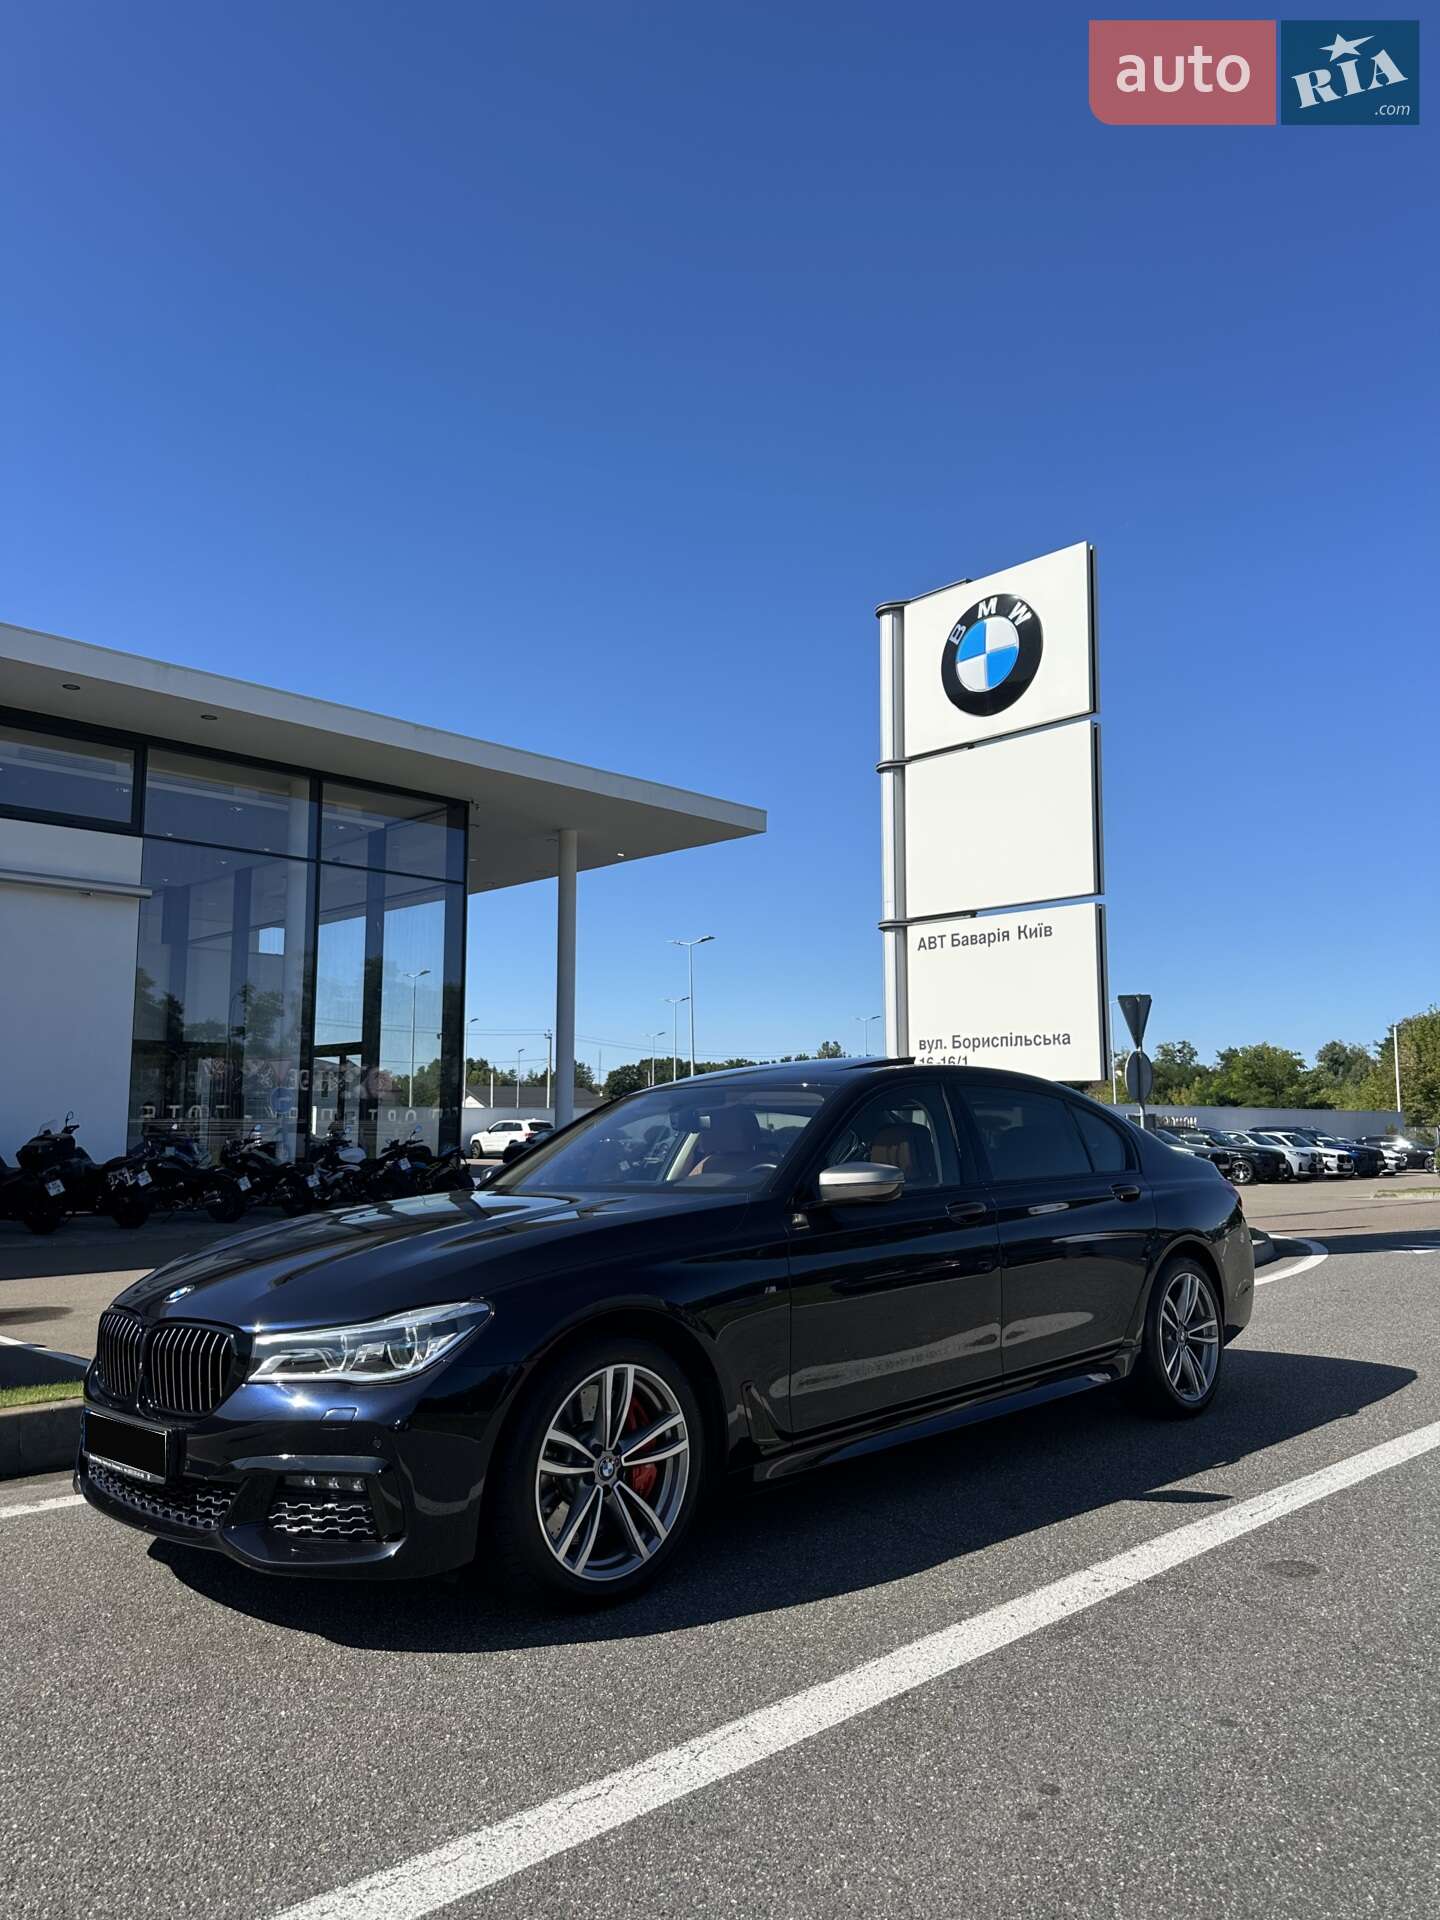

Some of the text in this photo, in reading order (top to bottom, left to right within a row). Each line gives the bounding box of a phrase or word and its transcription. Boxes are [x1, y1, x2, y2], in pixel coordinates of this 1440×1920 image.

[949, 597, 1032, 645] BMW
[917, 923, 1053, 951] АВТ Баварія Київ
[919, 1032, 1071, 1054] вул. Бориспільська
